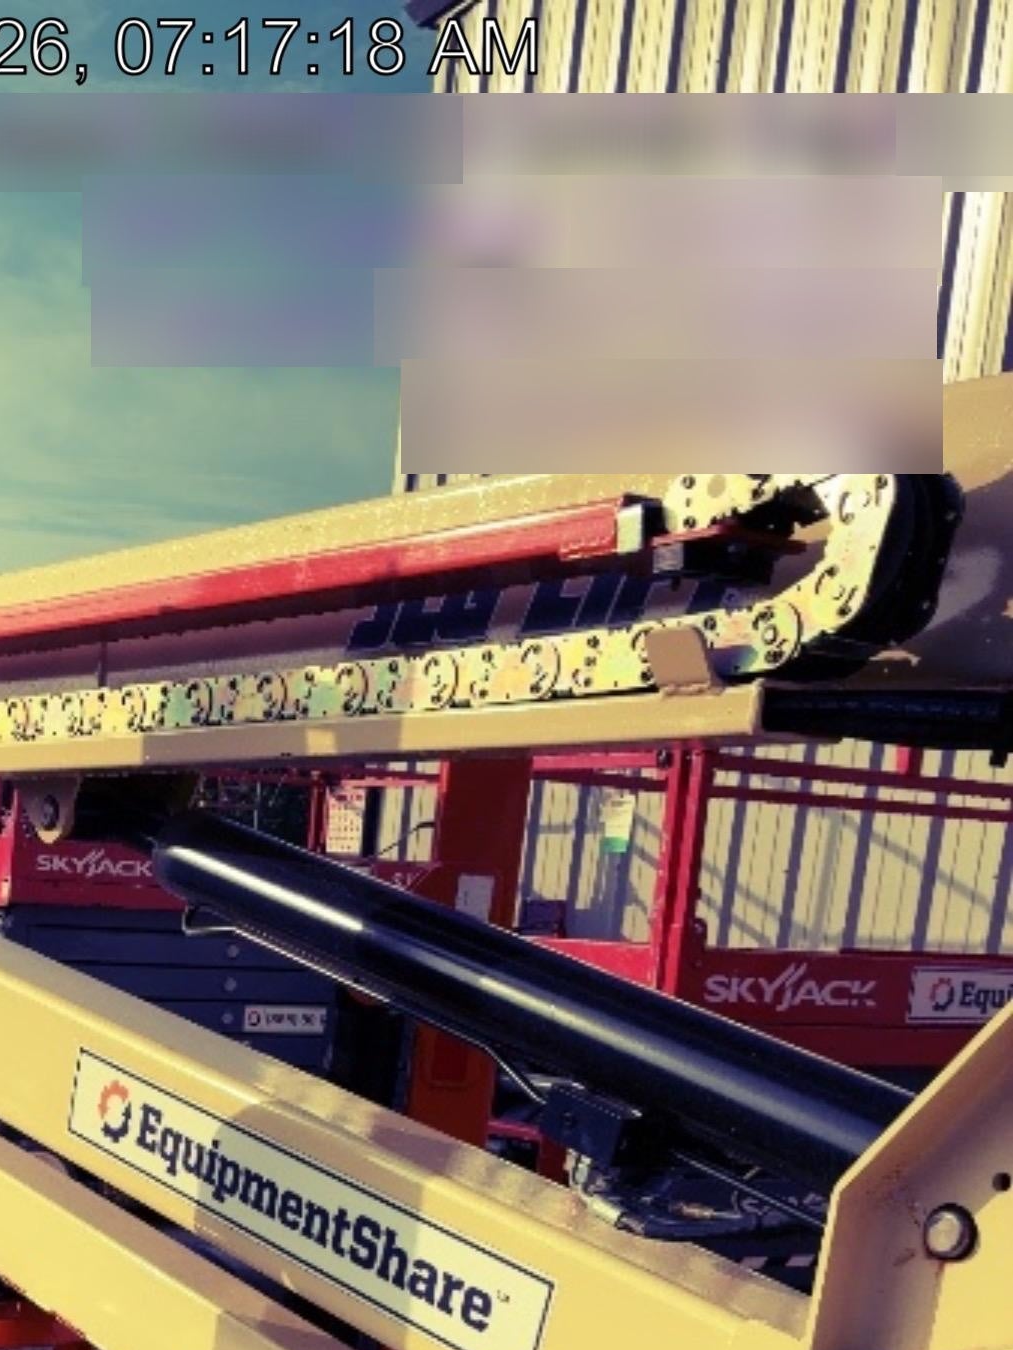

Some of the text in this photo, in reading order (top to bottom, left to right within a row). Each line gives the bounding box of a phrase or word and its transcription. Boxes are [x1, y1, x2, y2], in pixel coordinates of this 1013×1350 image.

[36, 847, 154, 878] SKYJACK
[702, 961, 878, 1012] SKYJACK
[137, 1102, 493, 1333] EquipmentShare
